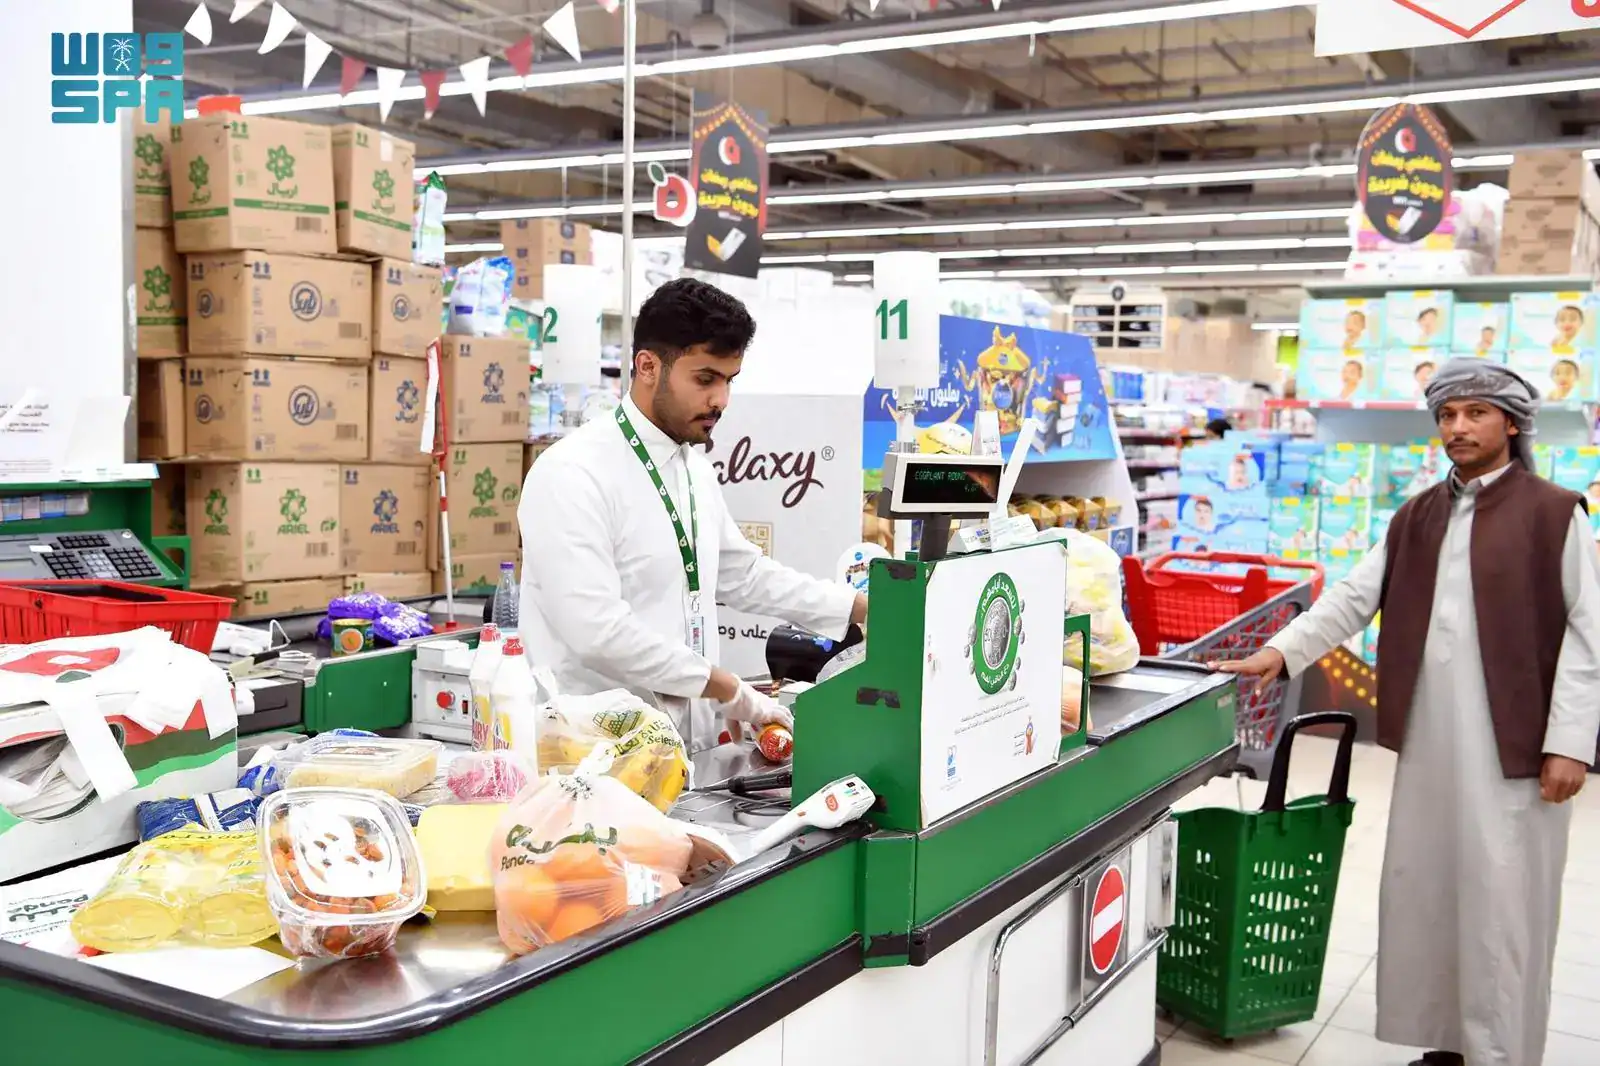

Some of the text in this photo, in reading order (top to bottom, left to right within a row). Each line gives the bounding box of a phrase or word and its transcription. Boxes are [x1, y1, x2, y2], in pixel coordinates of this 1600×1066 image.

[875, 299, 908, 340] 11
[706, 436, 824, 508] alaxy
[914, 471, 945, 481] EGGPLANT
[277, 523, 310, 535] ARIEL
[741, 623, 767, 640] على
